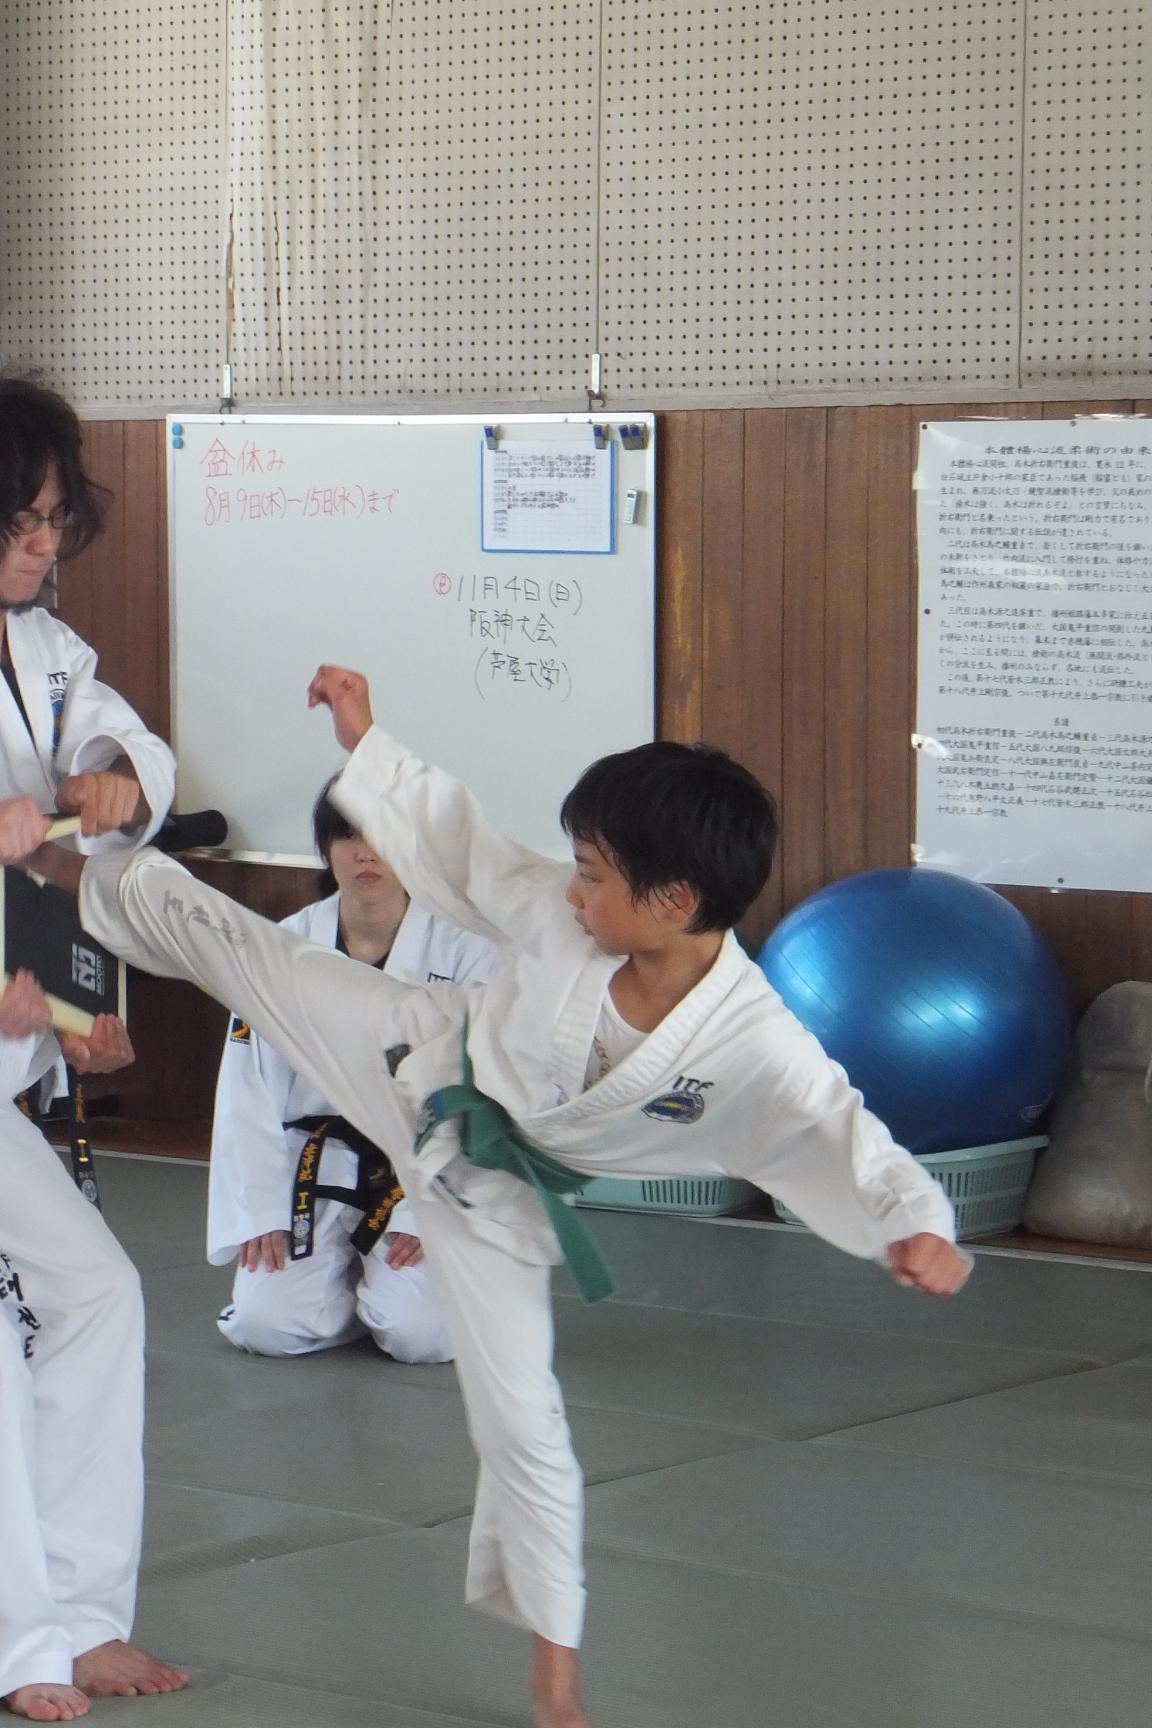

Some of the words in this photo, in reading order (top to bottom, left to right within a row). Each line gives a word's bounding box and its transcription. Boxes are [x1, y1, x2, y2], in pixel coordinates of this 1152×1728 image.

[200, 437, 285, 477] 盆休み
[469, 608, 557, 648] 阪神大会
